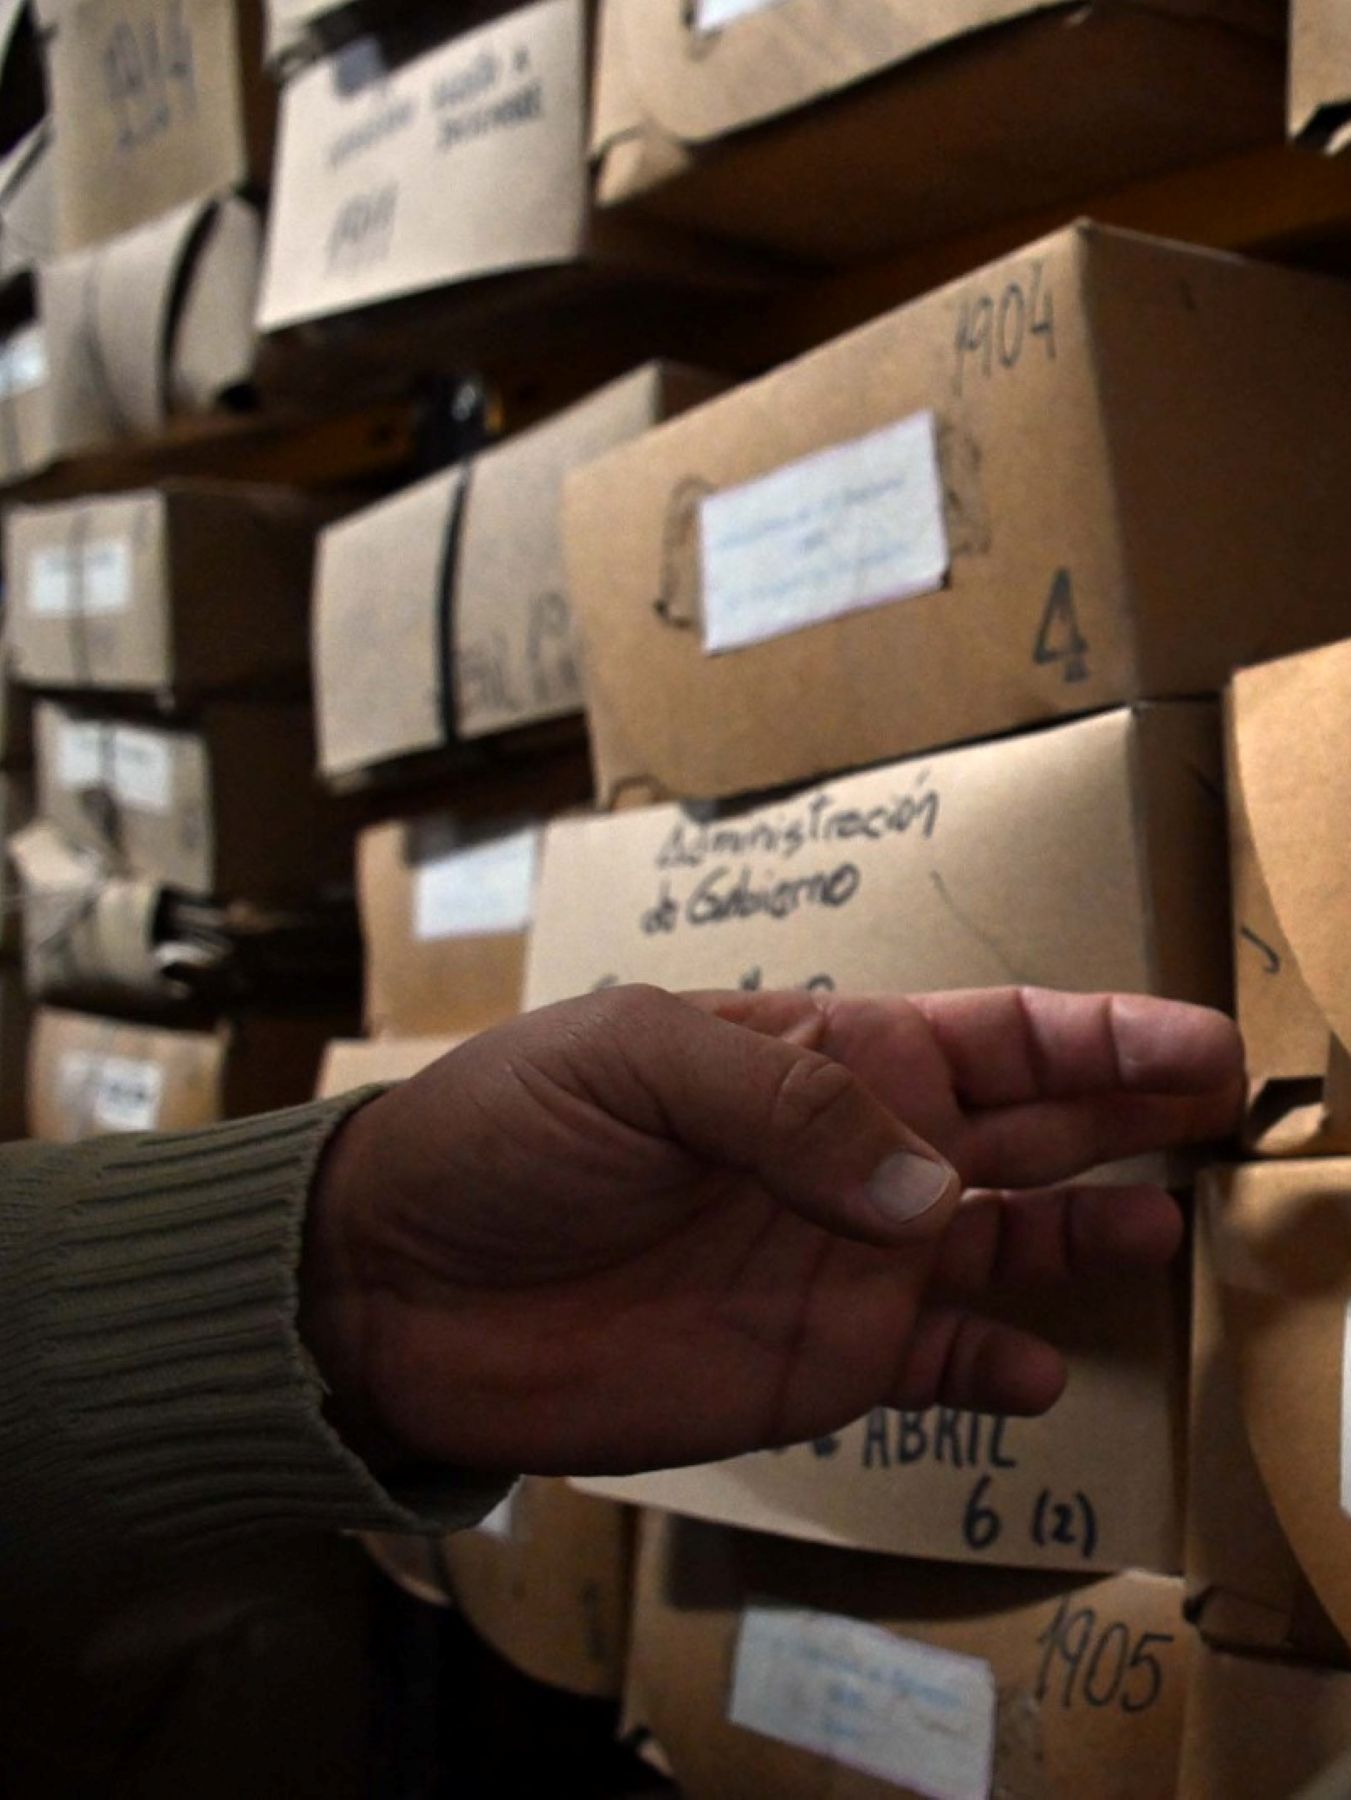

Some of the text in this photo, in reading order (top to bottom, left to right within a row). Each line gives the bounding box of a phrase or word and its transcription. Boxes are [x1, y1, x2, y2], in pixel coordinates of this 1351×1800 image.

[952, 261, 1057, 398] 1904
[1032, 566, 1092, 684] 4
[640, 862, 861, 936] de Gobierno
[862, 1405, 1017, 1468] ABRIL
[961, 1474, 1096, 1559] 6 (2)
[1035, 1596, 1175, 1714] 1905
